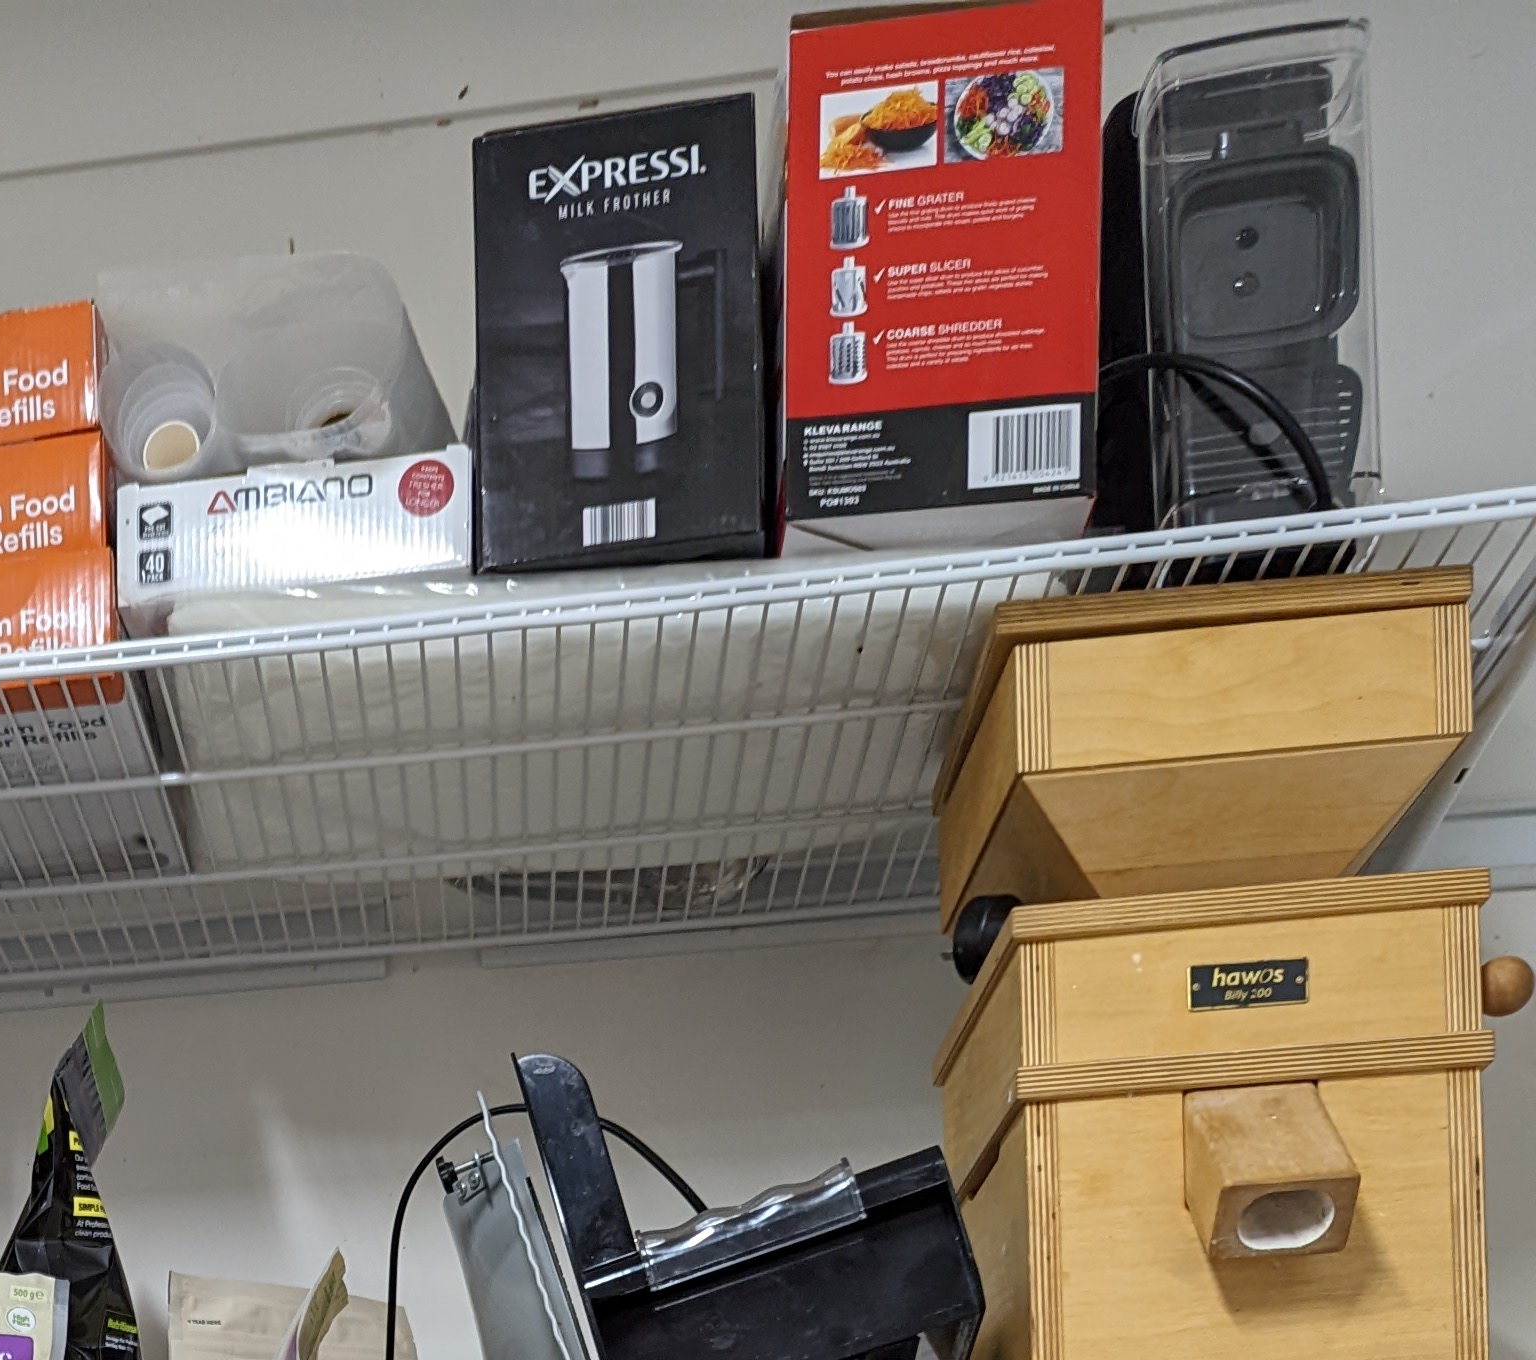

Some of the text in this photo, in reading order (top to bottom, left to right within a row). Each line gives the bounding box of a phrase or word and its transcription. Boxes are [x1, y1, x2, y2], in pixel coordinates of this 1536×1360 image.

[558, 188, 672, 221] MILK FROTHER
[888, 191, 965, 210] FINE GRATER
[887, 258, 972, 278] SUPER SLICER
[886, 318, 1003, 341] COARSE SHREDDER
[3, 359, 70, 393] Food
[10, 485, 76, 521] Food
[206, 474, 374, 516] AMBIANO
[144, 552, 166, 575] 40
[1212, 967, 1286, 988] hawos
[1250, 987, 1273, 999] 200
[14, 1288, 28, 1298] 500
